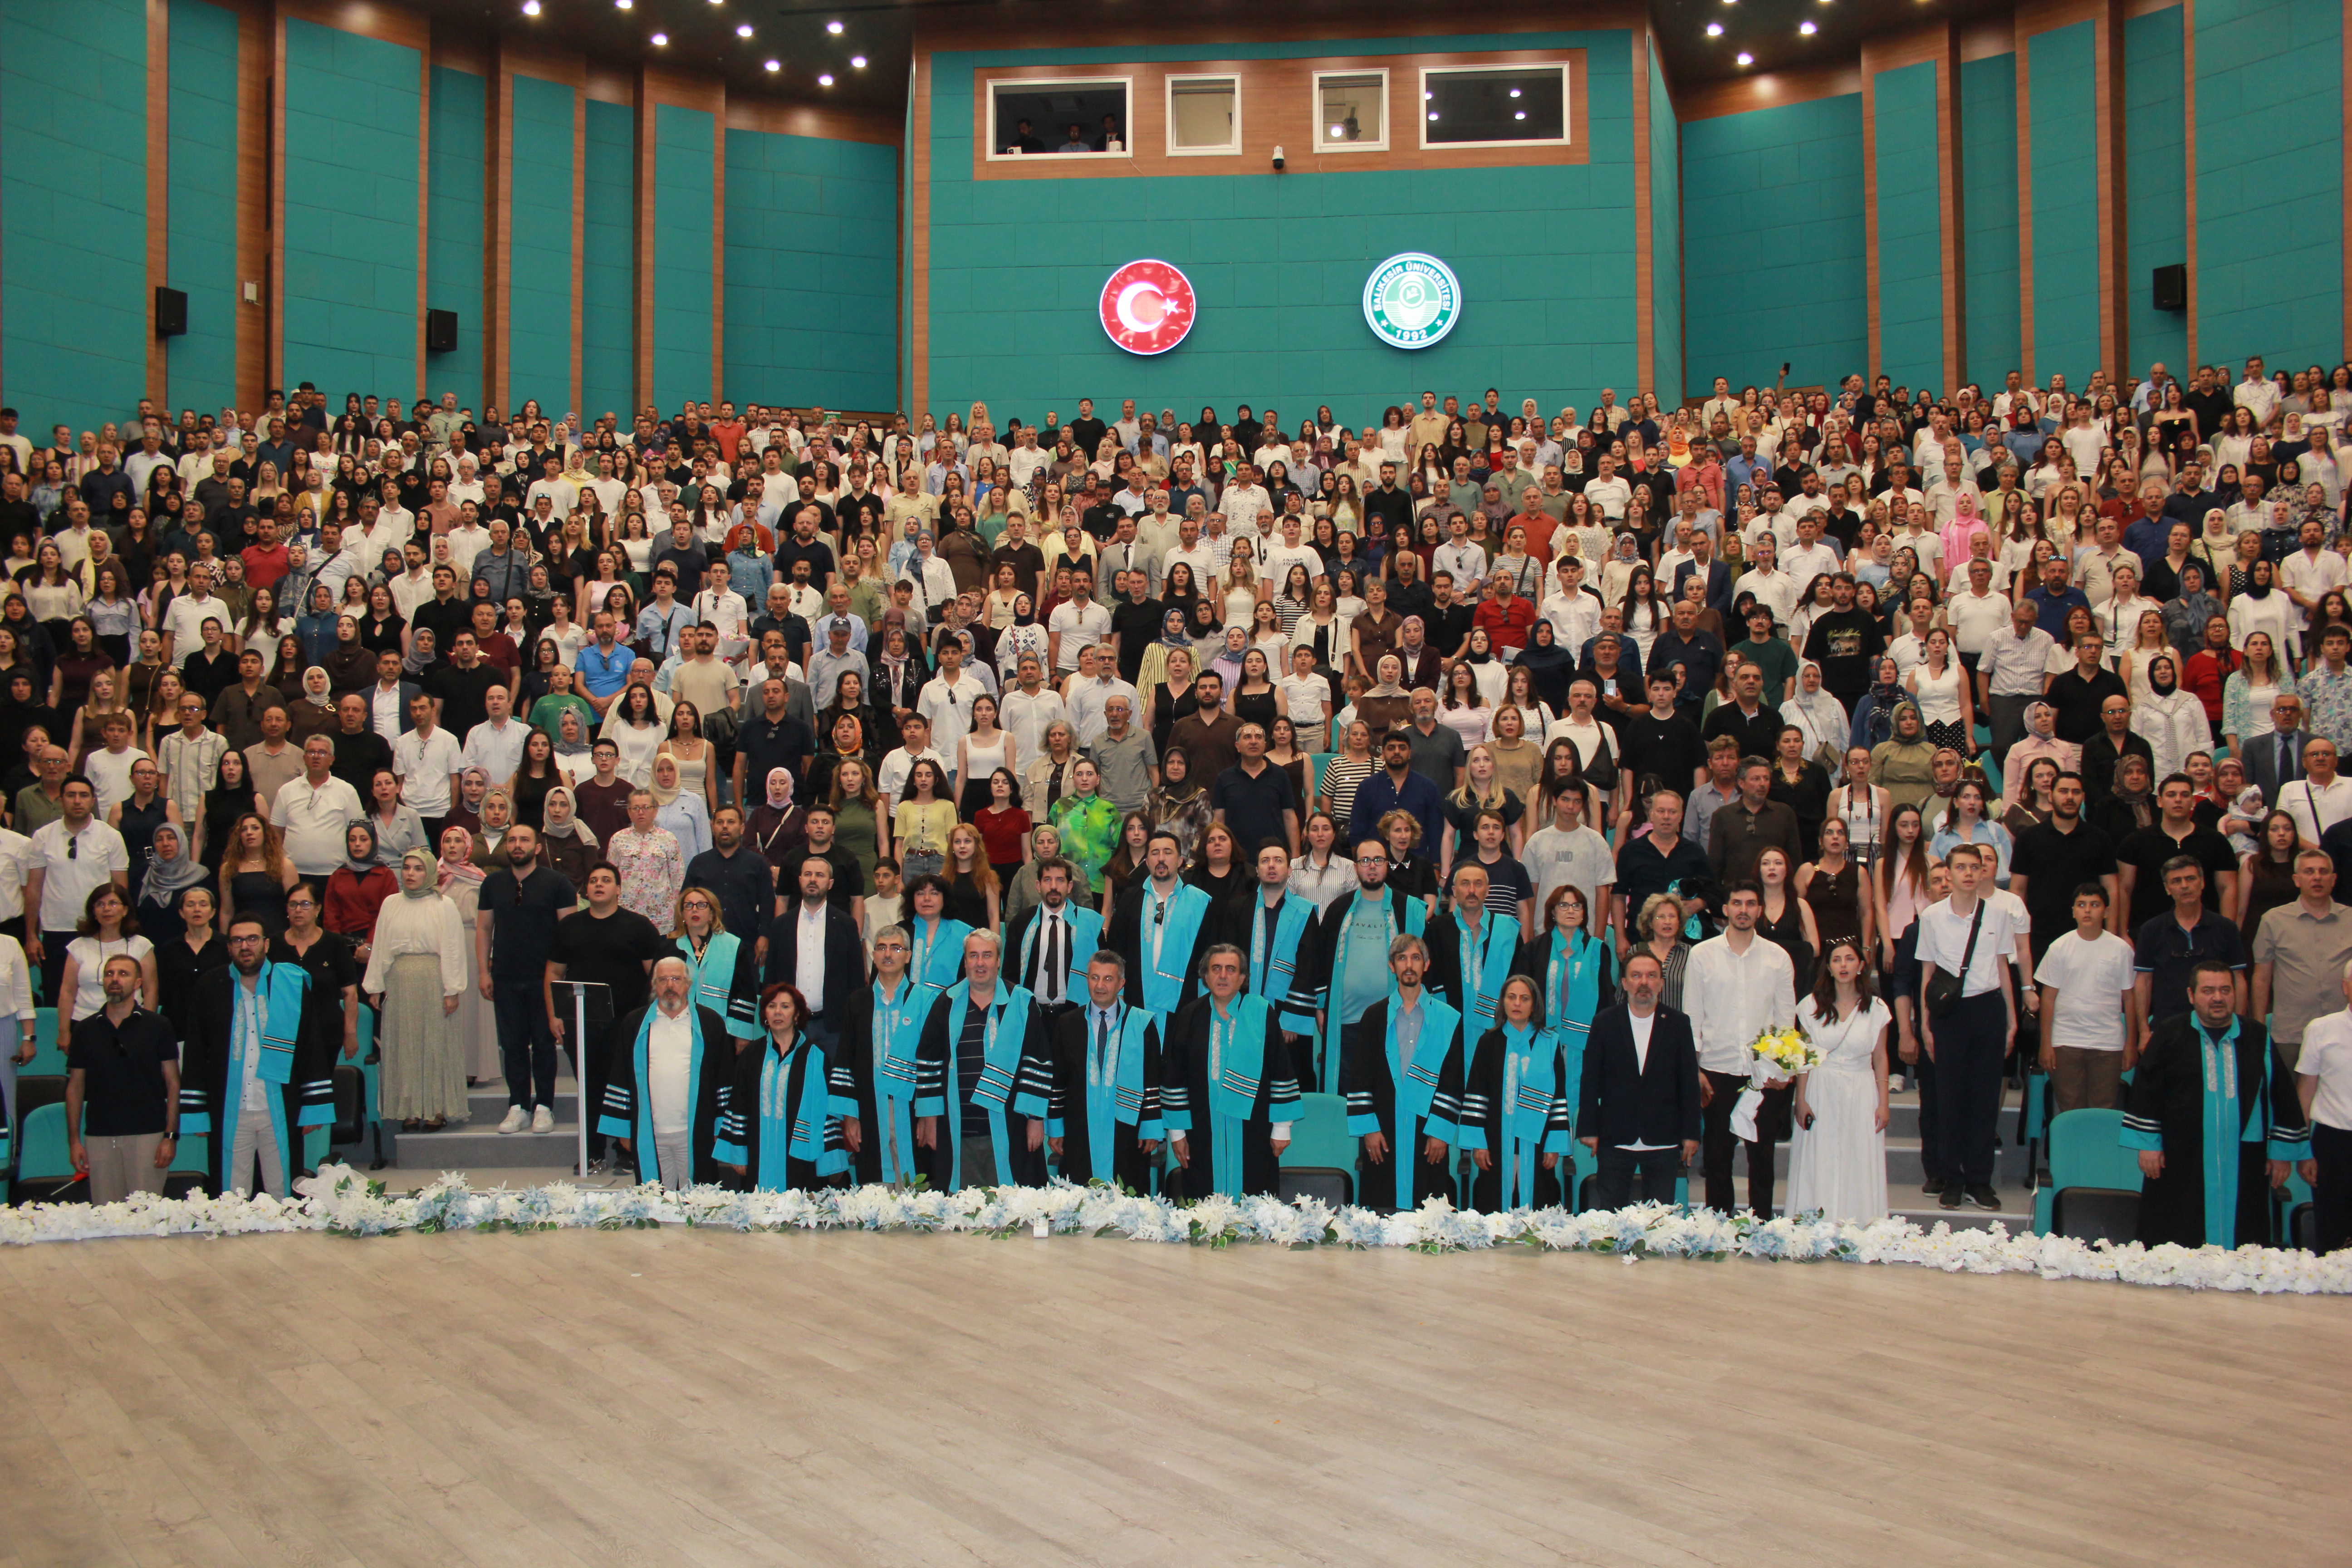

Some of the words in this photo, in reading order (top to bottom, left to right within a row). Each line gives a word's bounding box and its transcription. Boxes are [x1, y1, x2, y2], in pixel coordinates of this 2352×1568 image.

[1374, 265, 1404, 311] BALIKESİR
[1406, 261, 1451, 311] ÜNİVERSİTESİ
[1396, 329, 1428, 341] 1992
[1554, 851, 1573, 862] AND
